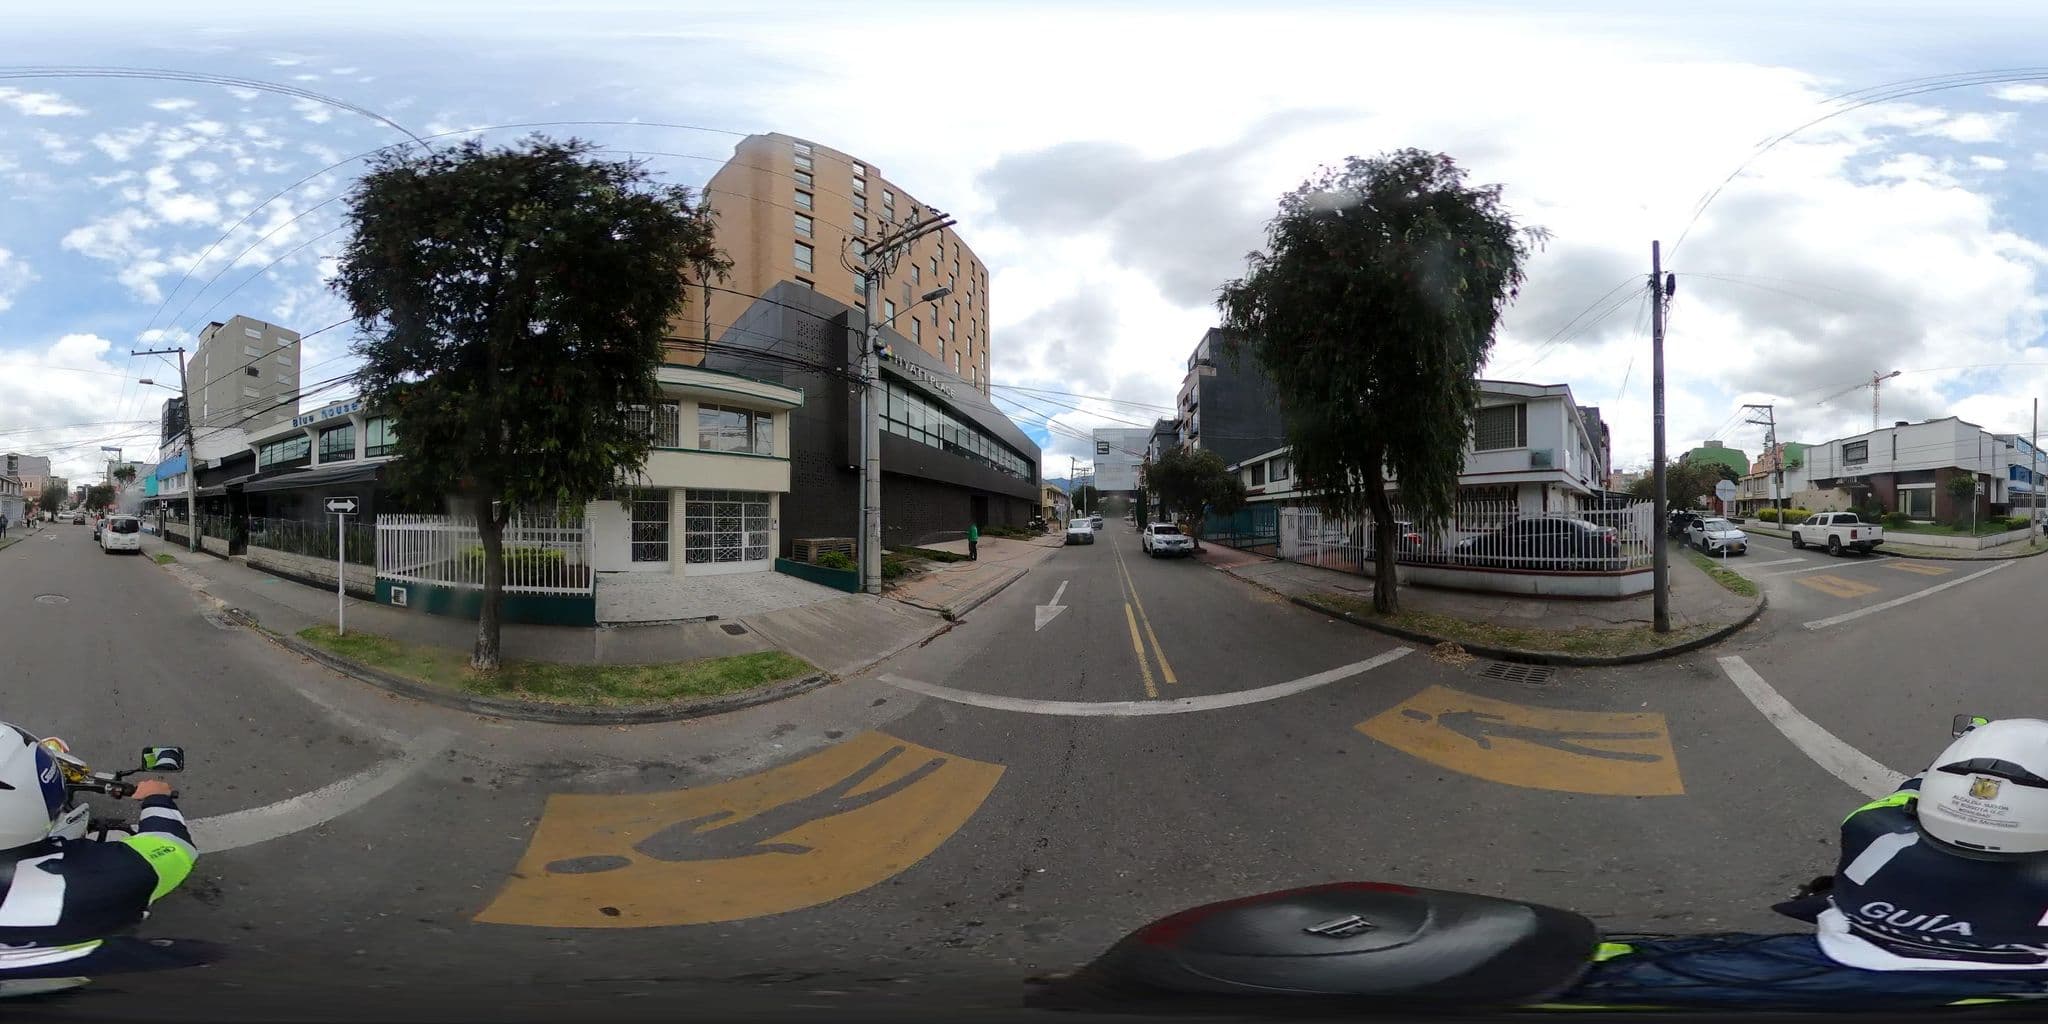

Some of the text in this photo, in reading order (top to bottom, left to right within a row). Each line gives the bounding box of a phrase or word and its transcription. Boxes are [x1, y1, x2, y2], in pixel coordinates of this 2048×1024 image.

[895, 354, 957, 399] HYATT PLACE
[1860, 901, 1972, 936] GUÍA
